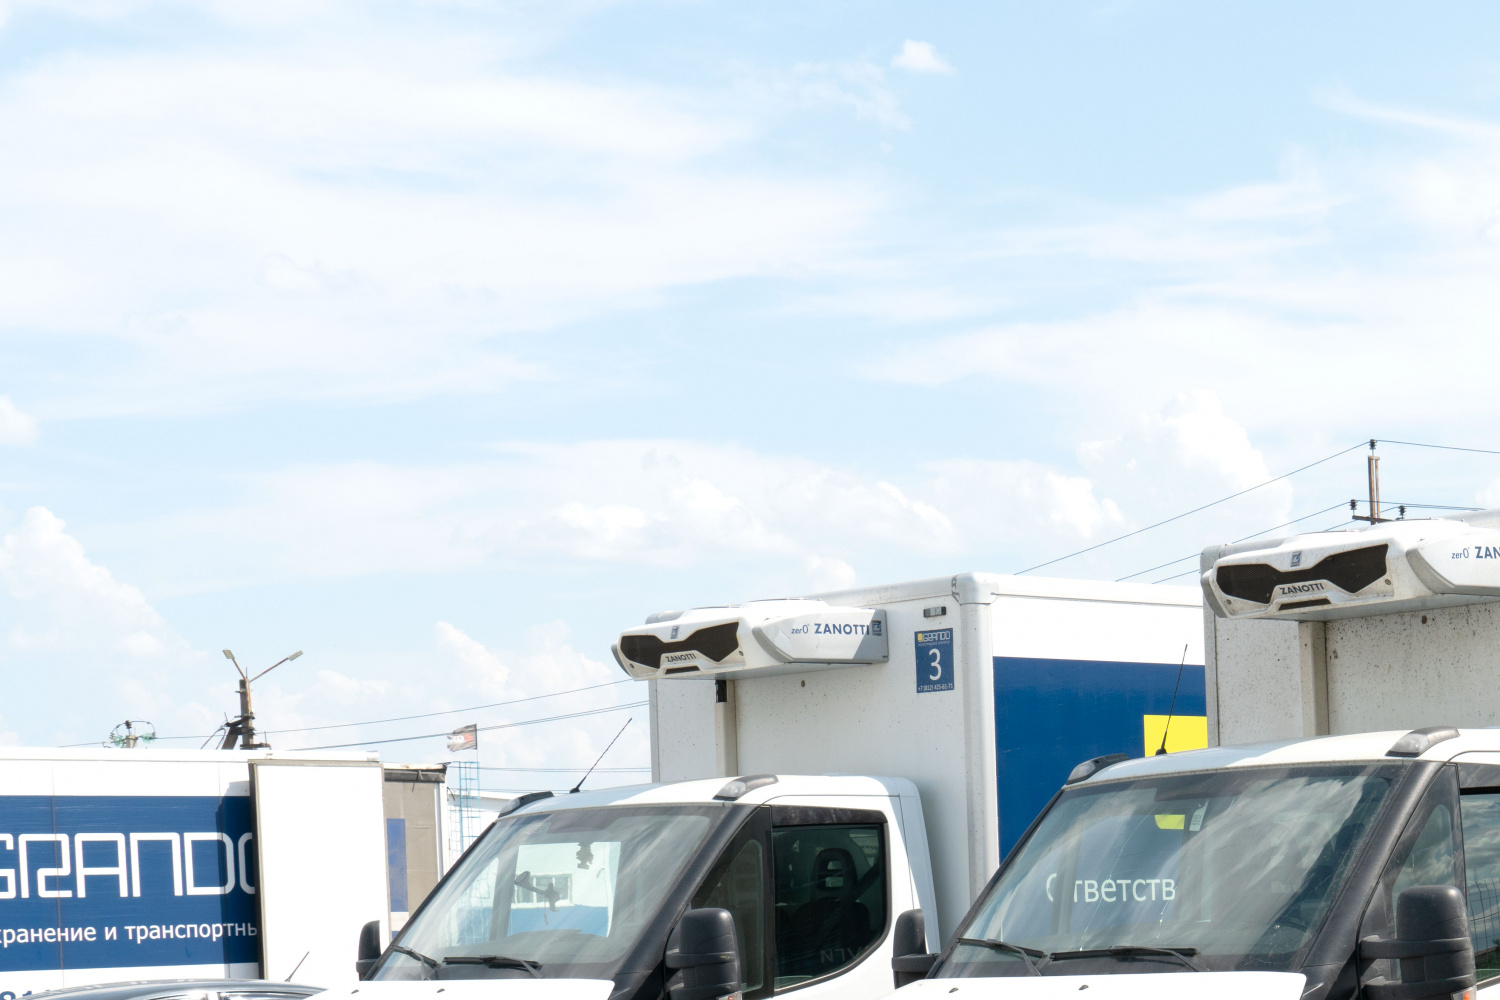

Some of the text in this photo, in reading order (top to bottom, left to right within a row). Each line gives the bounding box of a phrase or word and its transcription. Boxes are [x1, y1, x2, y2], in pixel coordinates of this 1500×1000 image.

[1279, 582, 1325, 595] ZANOTTI
[814, 623, 870, 636] ZANOTTI
[665, 653, 697, 663] ZANOTTI
[929, 648, 942, 681] 3
[0, 925, 97, 948] ранение
[104, 926, 117, 940] и
